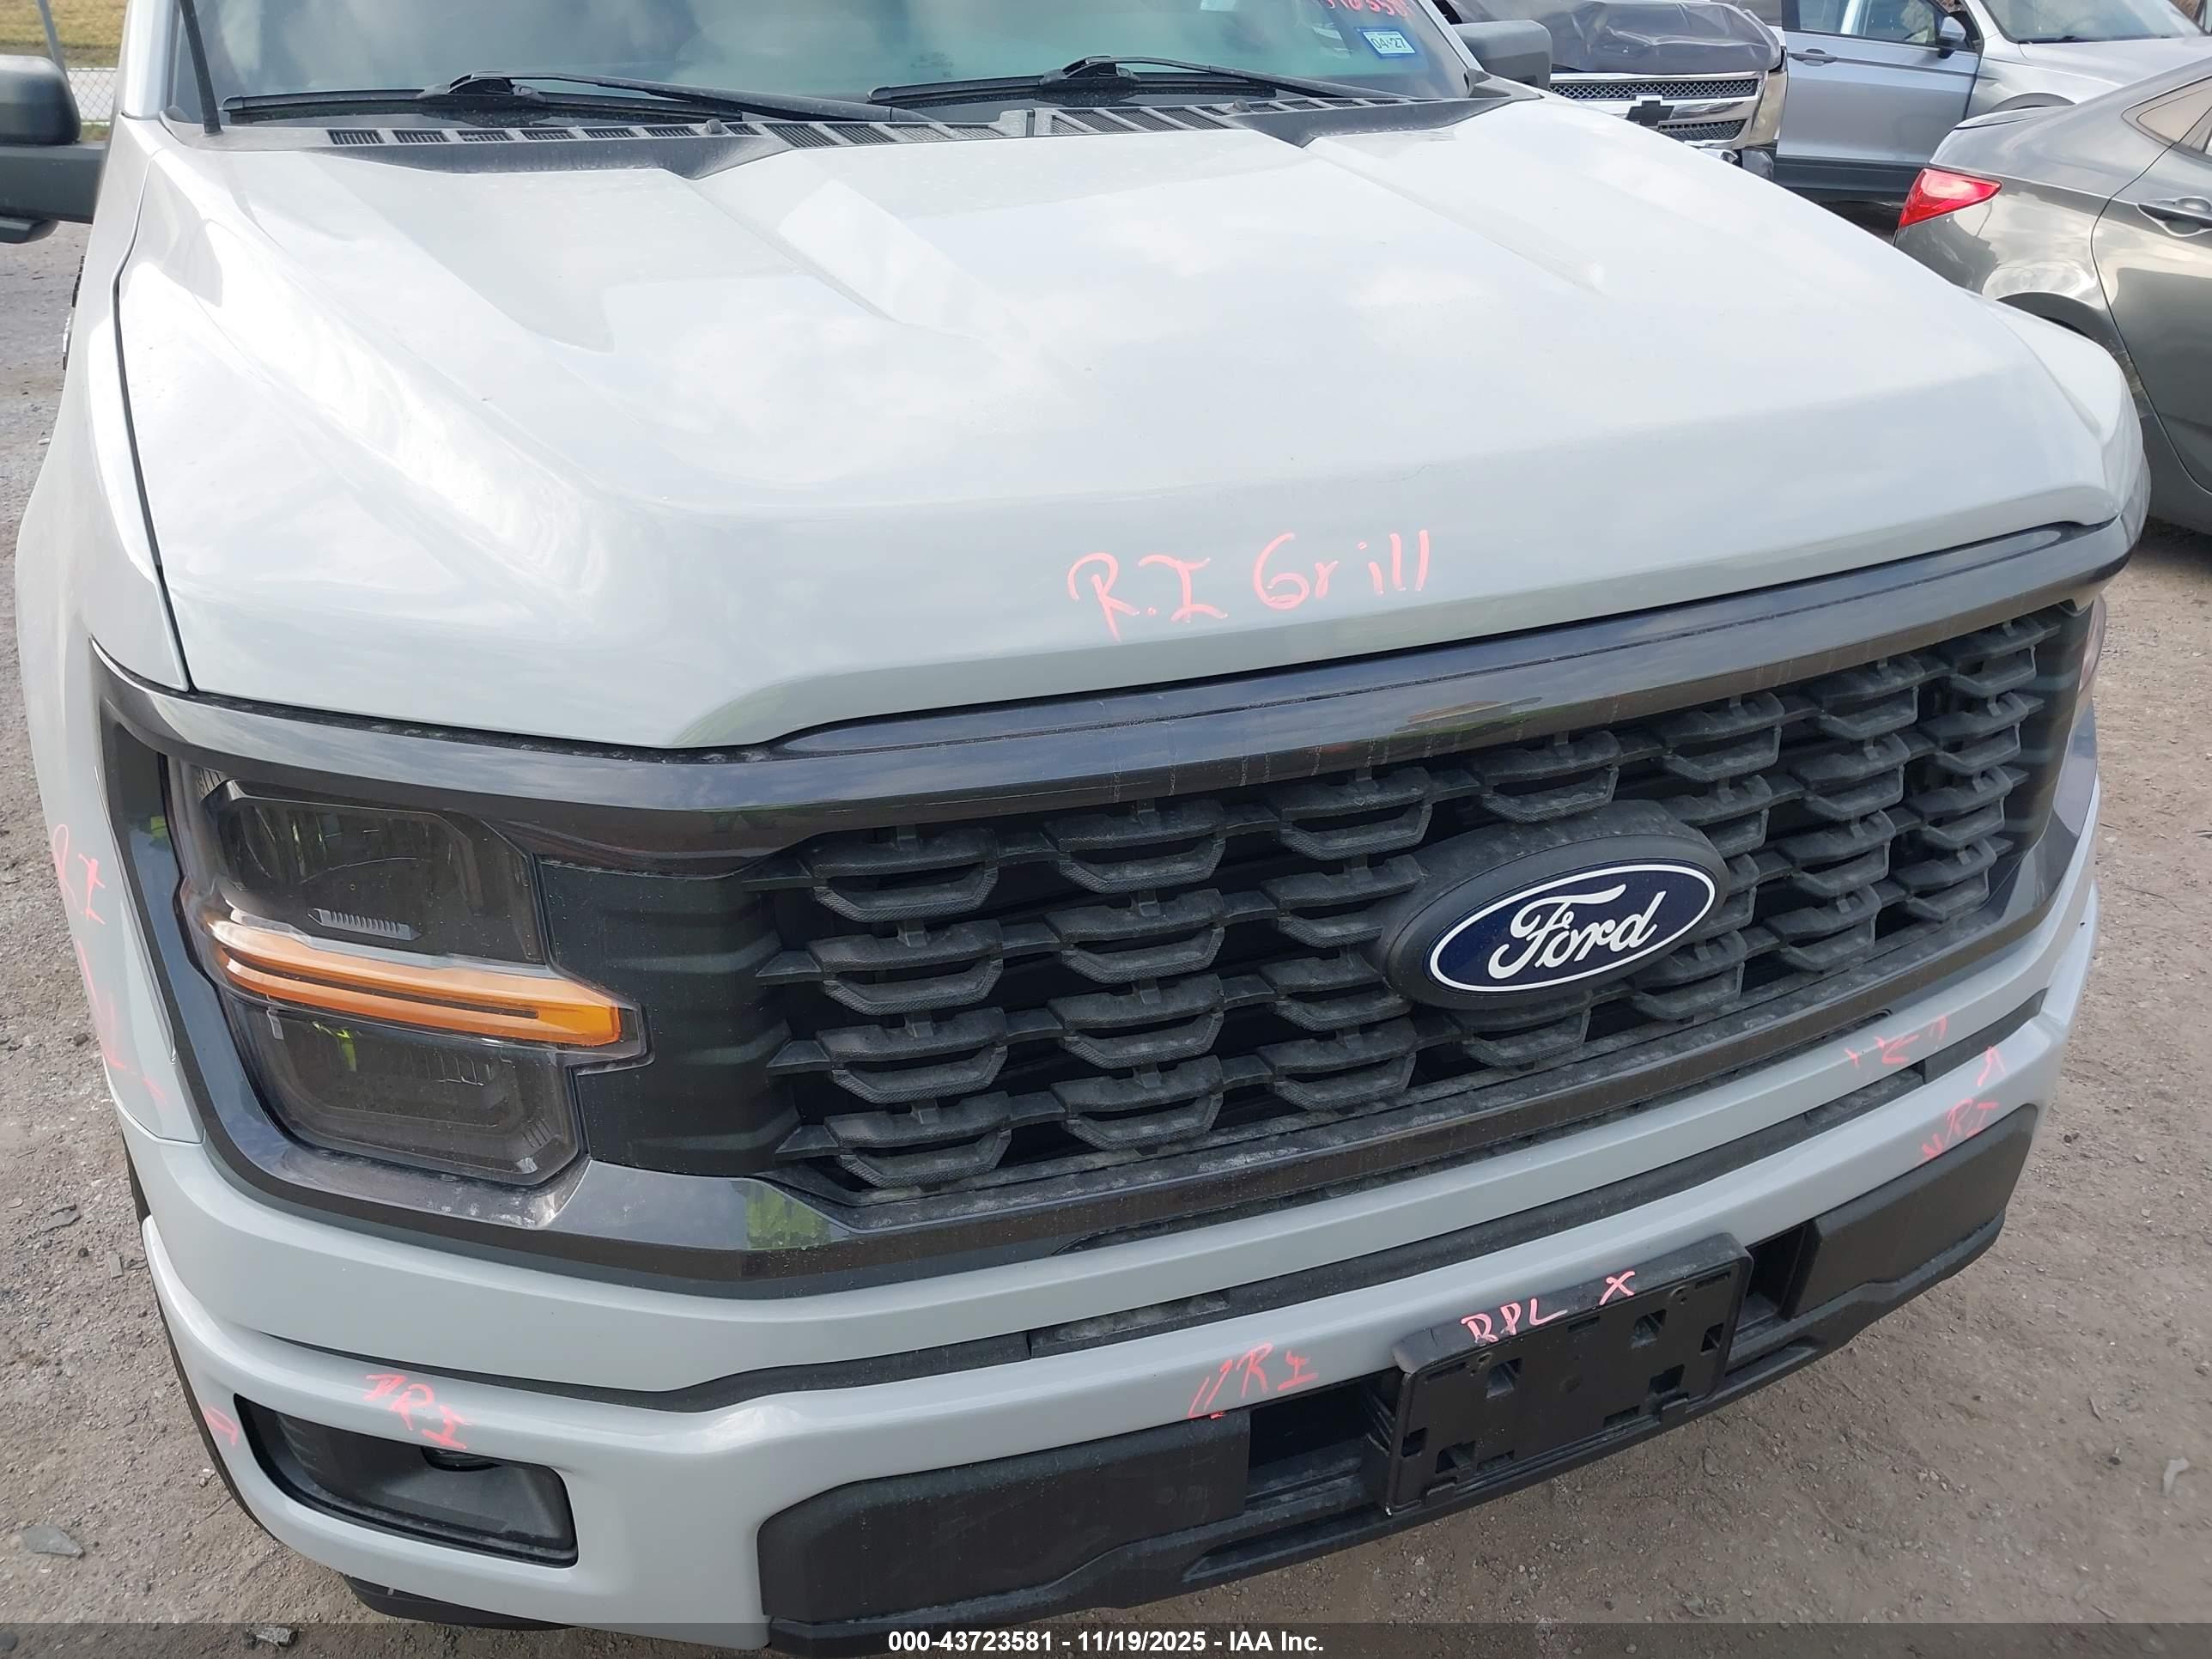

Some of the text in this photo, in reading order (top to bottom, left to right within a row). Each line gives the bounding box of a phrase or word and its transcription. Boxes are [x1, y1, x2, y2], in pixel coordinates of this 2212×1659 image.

[1253, 529, 1430, 610] Grill
[1487, 884, 1667, 980] Ford
[1461, 1297, 1568, 1345] RPL
